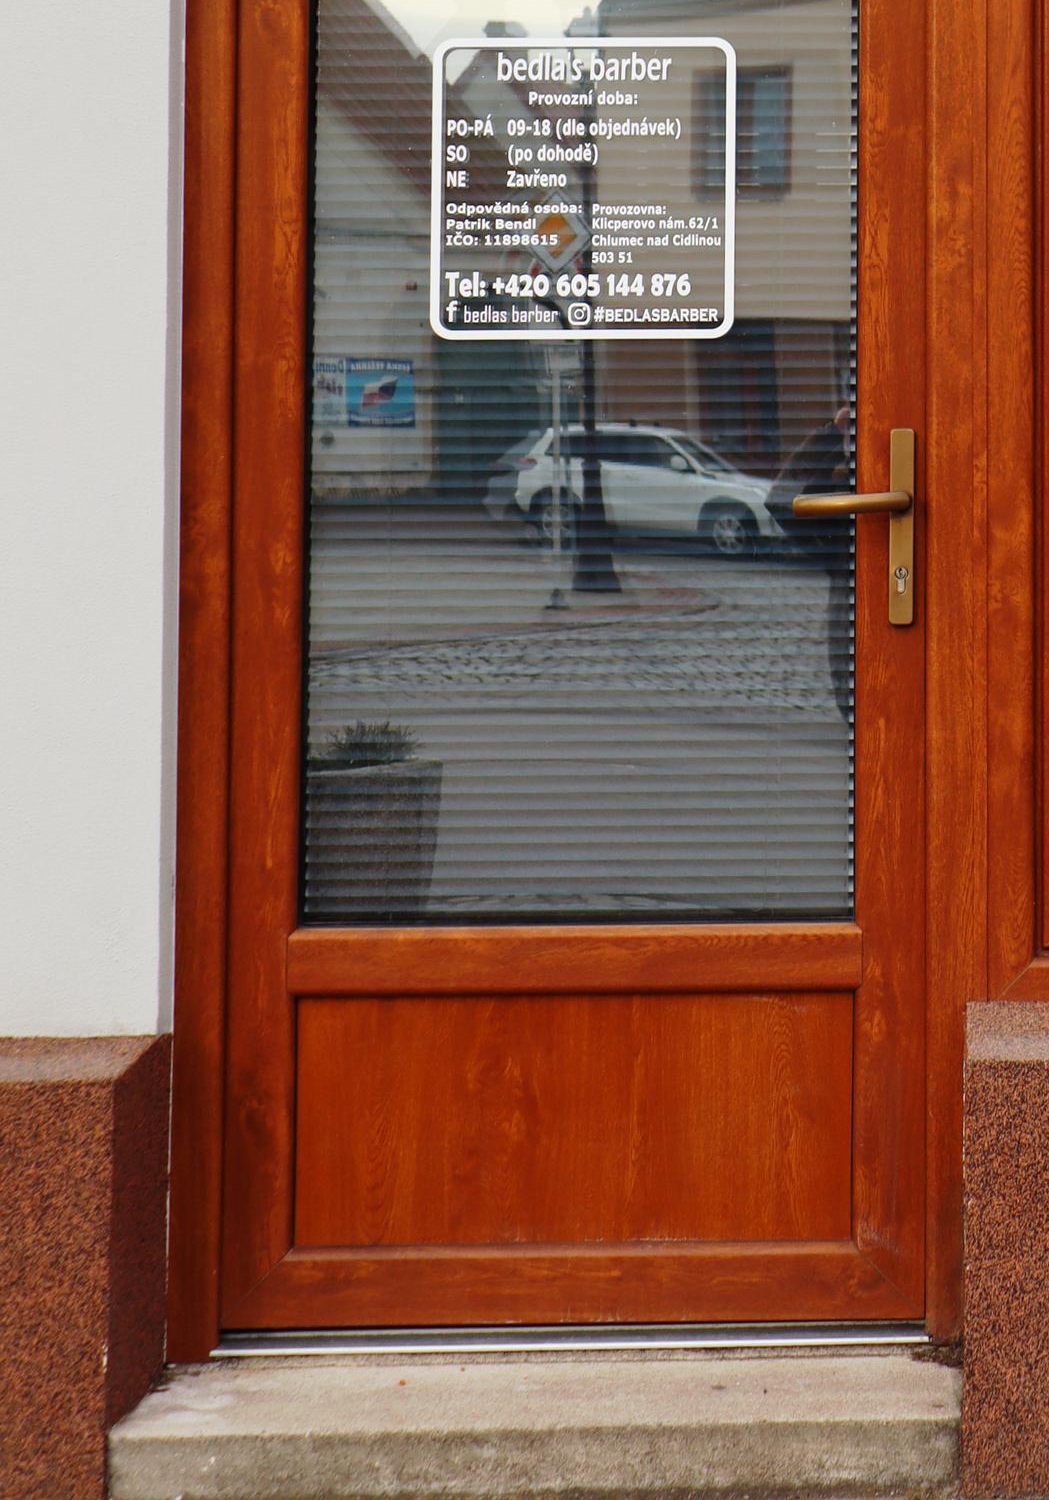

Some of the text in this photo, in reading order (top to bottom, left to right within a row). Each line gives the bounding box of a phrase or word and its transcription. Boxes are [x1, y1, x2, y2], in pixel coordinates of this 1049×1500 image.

[497, 52, 672, 81] bedla's barber
[528, 89, 638, 105] Provozní doba:
[447, 114, 681, 140] PO-PÁ 09-18 (dle objednávek)
[446, 142, 599, 166] SO (po dohodě)
[446, 168, 567, 187] NE Zavřeno
[446, 201, 582, 216] Odpovědná osoba:
[592, 203, 666, 215] Provozovna:
[446, 218, 536, 230] Patrik Bendl
[592, 215, 718, 232] Klicperovo nám.62/1
[446, 231, 558, 246] IČO: 11898615
[591, 233, 721, 247] Chlumec nad Cidlinou
[591, 251, 633, 264] 503 51
[445, 271, 691, 297] Tel: +420 605 144 876
[464, 304, 558, 323] bedlas barber
[593, 306, 718, 323] #BEDLASBARBER
